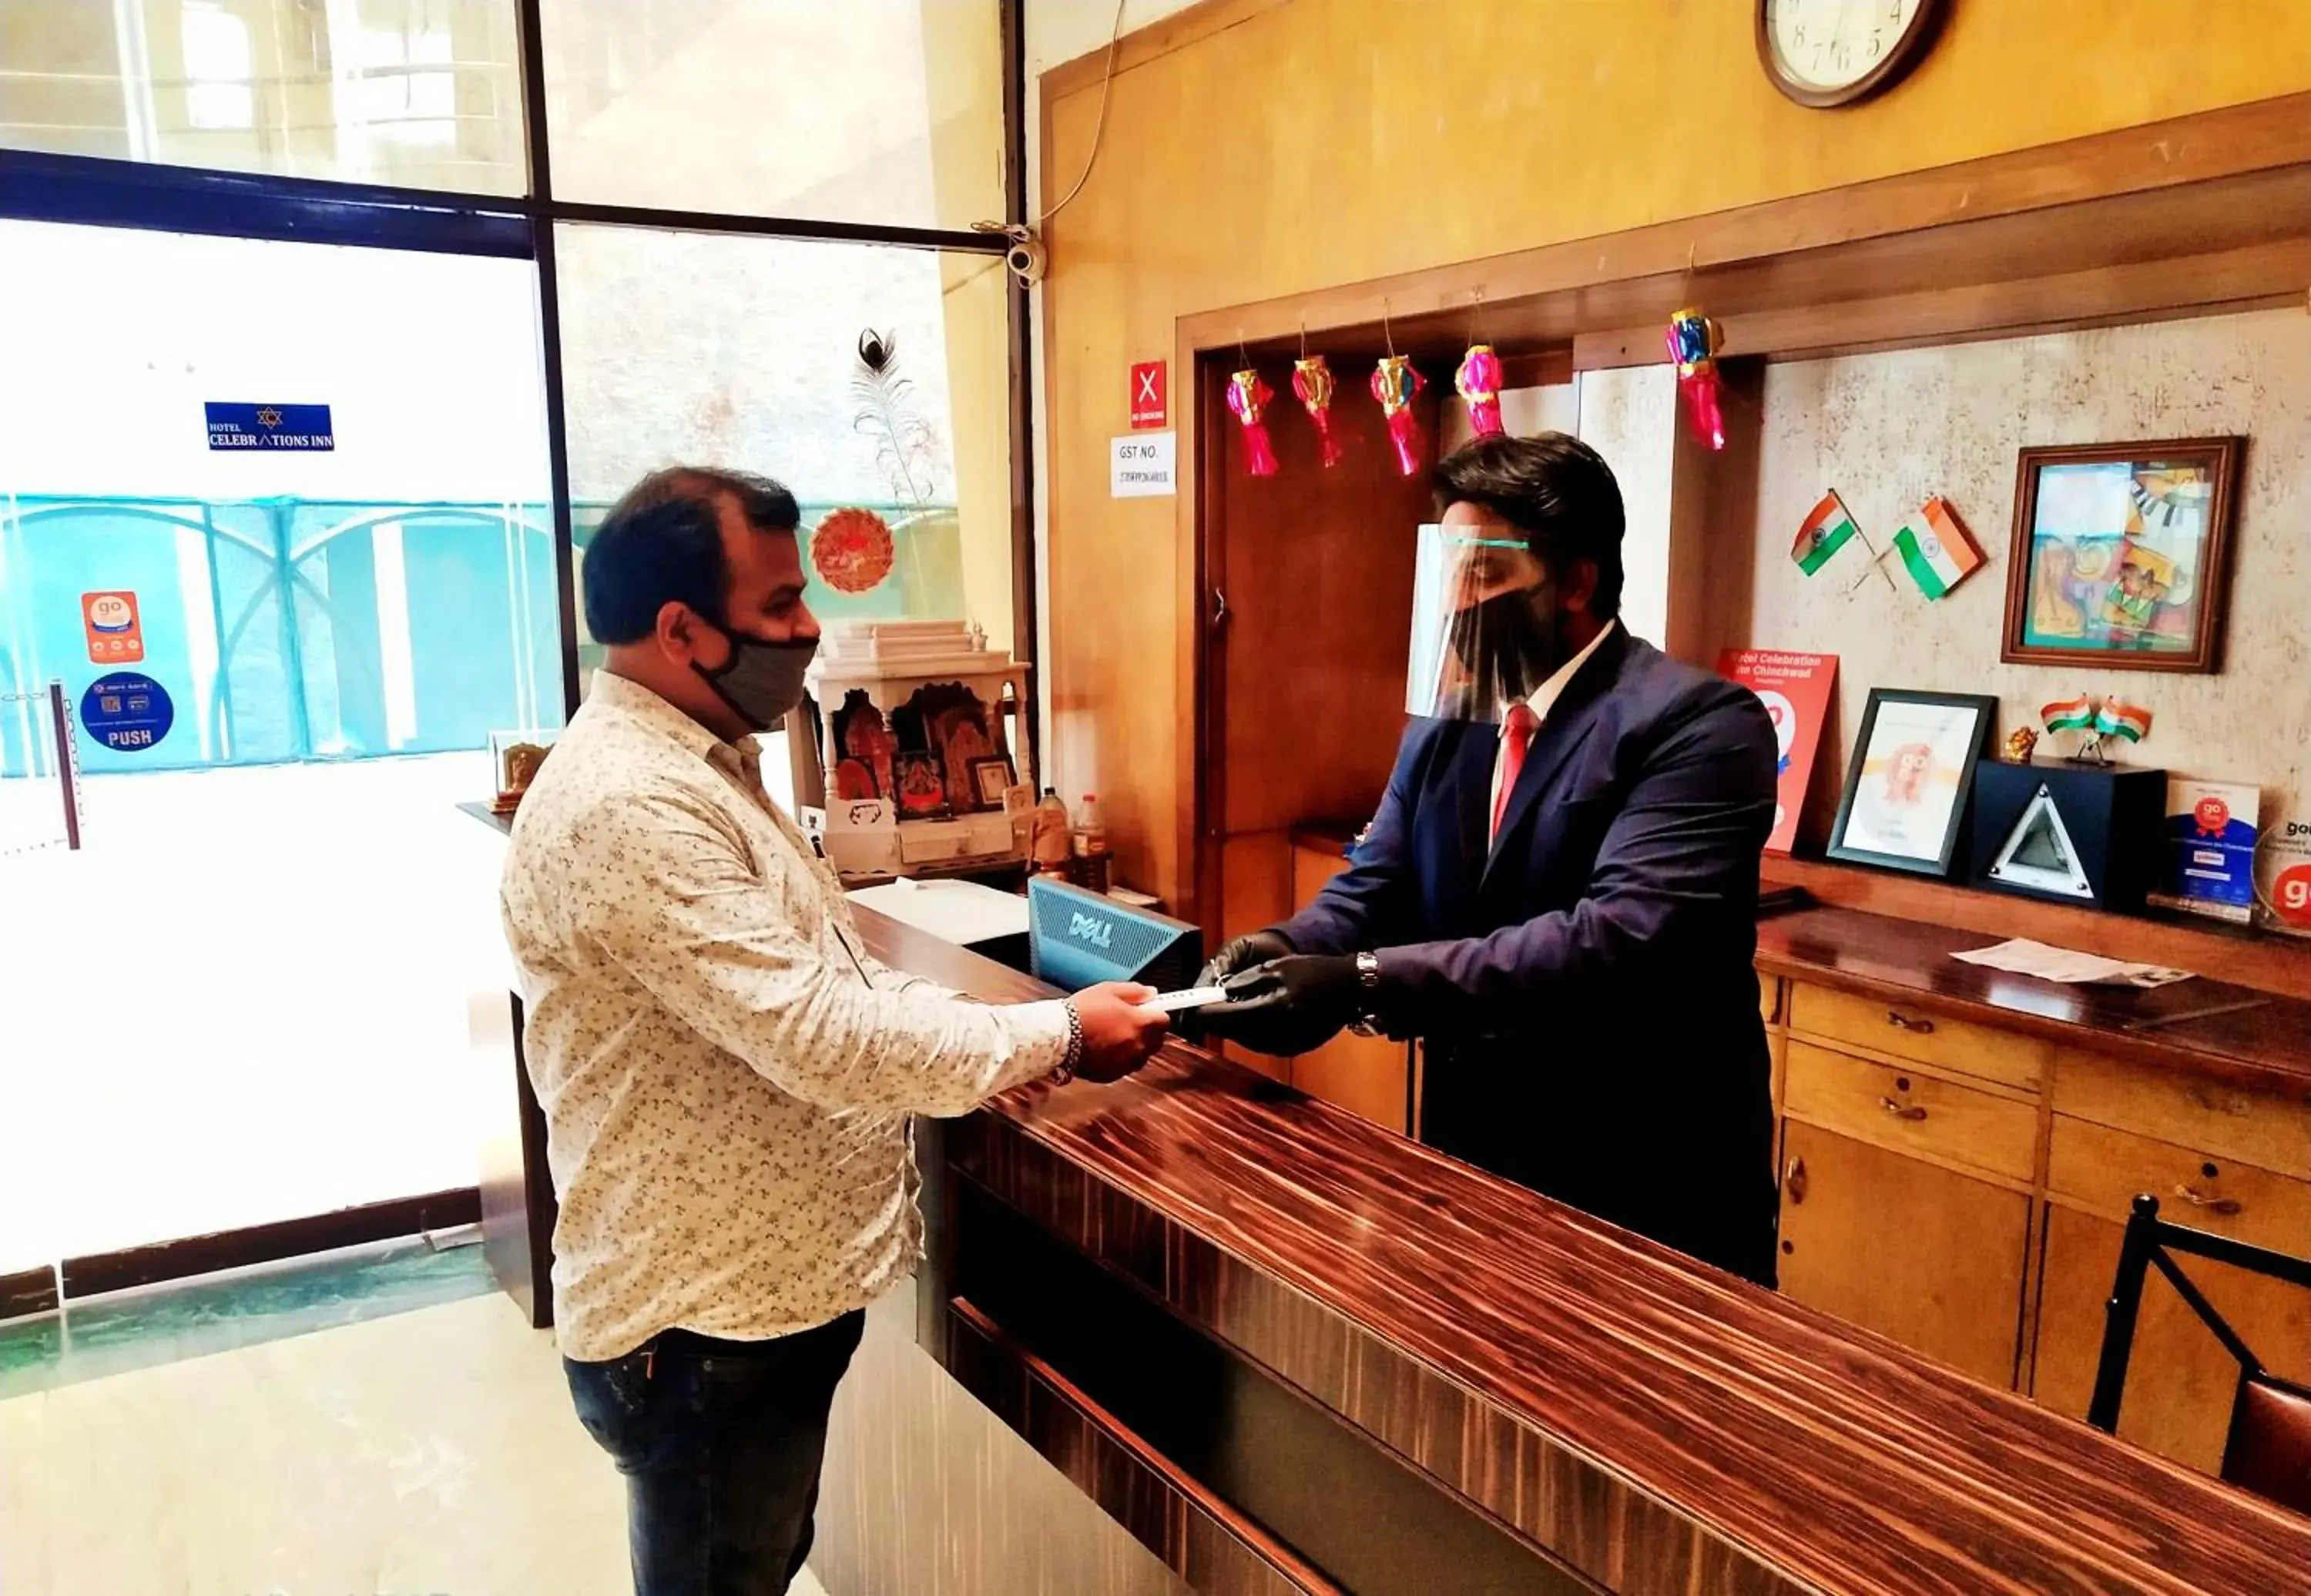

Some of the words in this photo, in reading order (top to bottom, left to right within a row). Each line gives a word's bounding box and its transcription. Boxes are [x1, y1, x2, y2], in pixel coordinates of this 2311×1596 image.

[1890, 0, 1901, 24] 4
[1793, 24, 1806, 49] 8
[1867, 28, 1882, 56] 5
[1813, 42, 1823, 71] 7
[209, 423, 241, 432] HOTEL
[311, 435, 333, 447] INN
[1119, 445, 1138, 458] GST
[98, 602, 121, 615] go
[109, 729, 152, 746] PUSH
[2285, 880, 2311, 909] g
[1068, 911, 1112, 948] DELL
